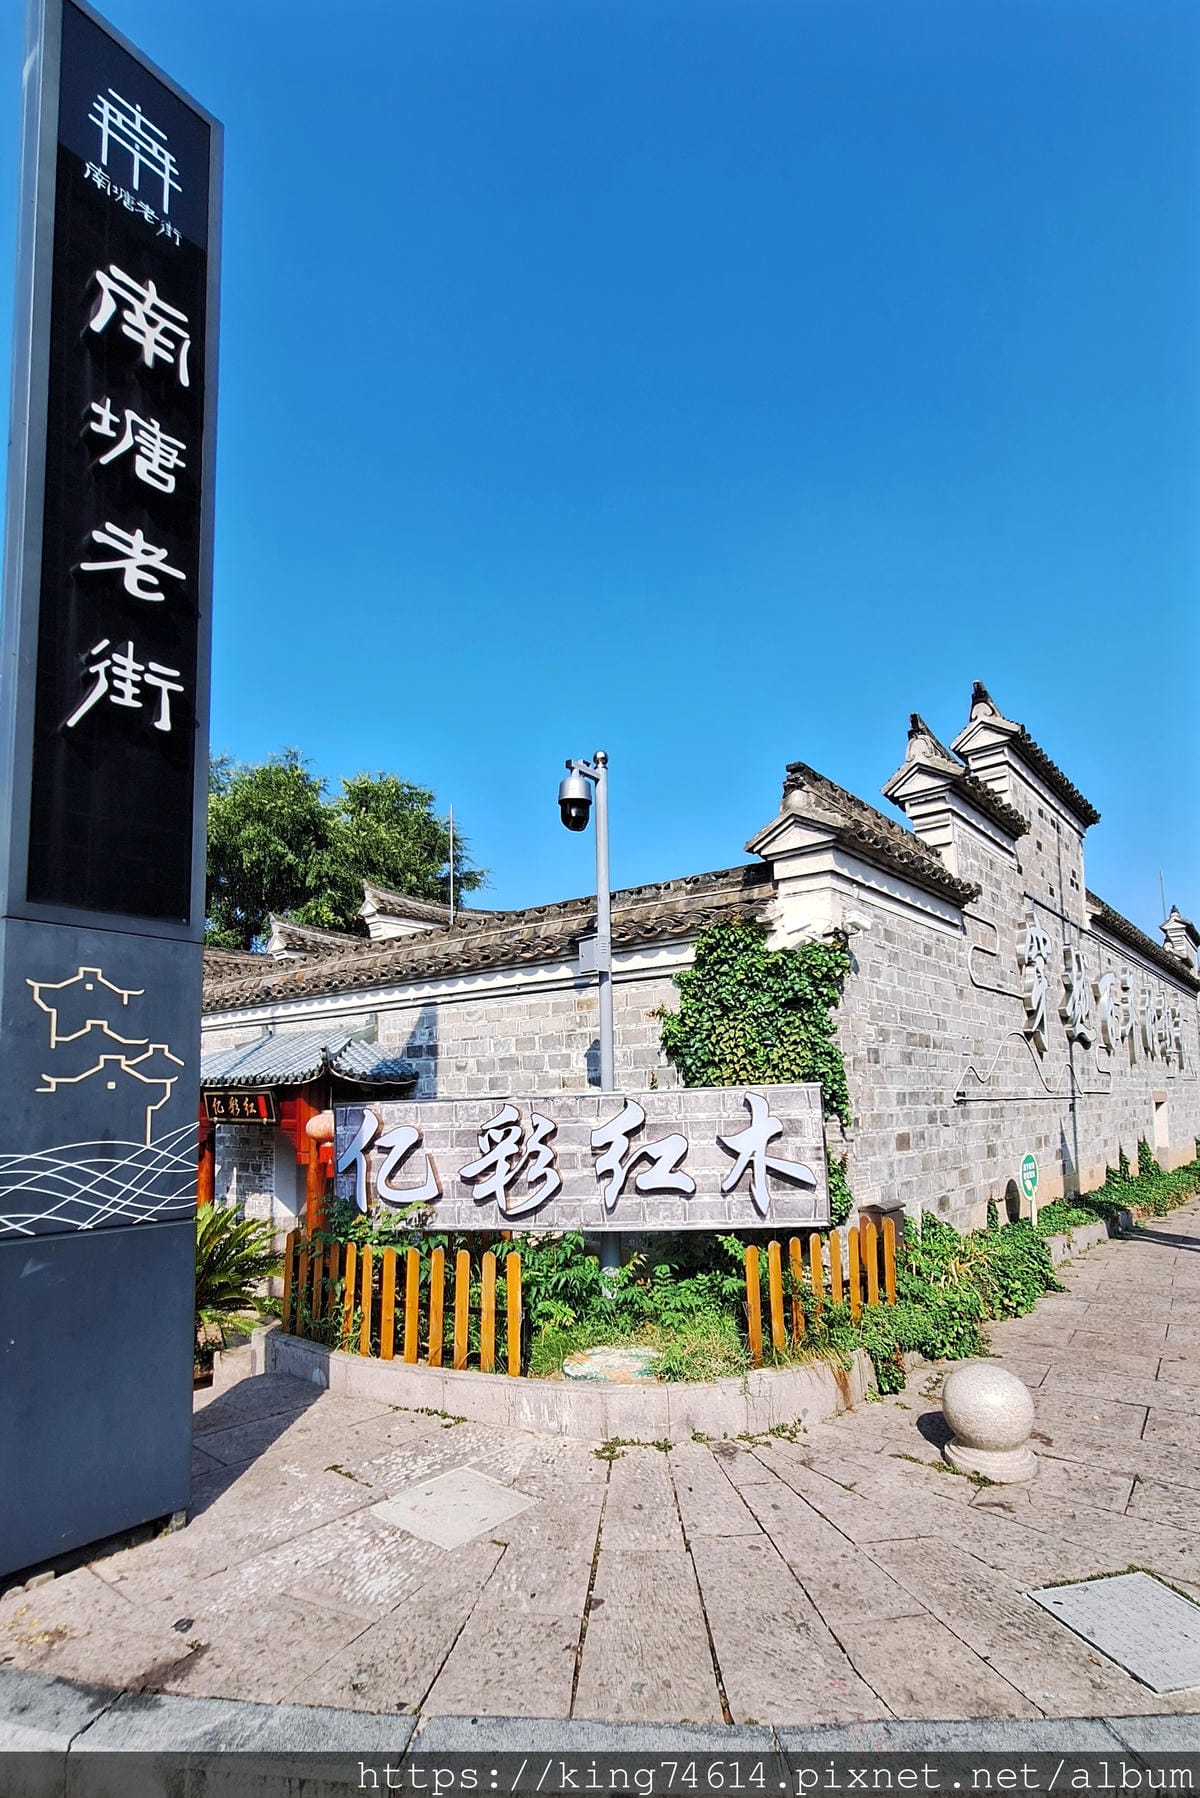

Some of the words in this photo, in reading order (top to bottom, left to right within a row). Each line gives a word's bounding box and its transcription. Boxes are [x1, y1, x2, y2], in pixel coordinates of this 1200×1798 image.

[83, 161, 183, 247] 南塘老街
[66, 264, 191, 732] 南塘老街
[337, 1091, 819, 1217] 亿彩红木
